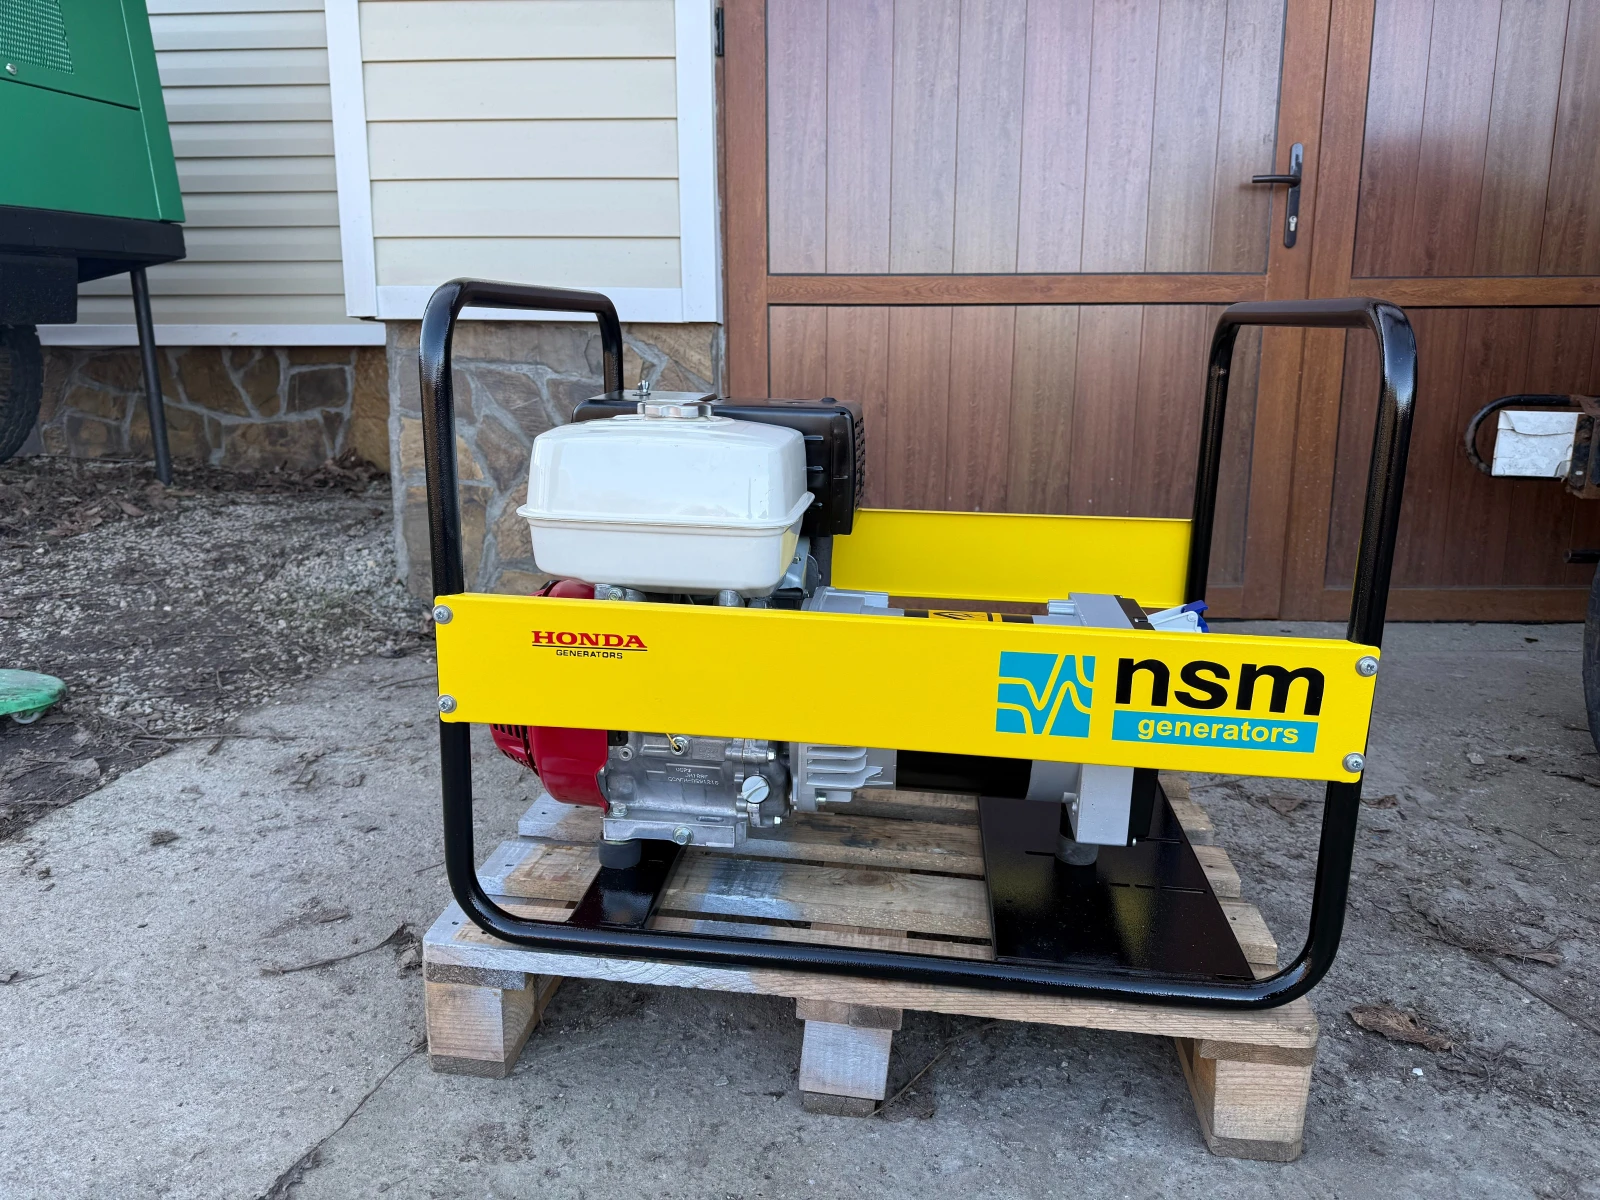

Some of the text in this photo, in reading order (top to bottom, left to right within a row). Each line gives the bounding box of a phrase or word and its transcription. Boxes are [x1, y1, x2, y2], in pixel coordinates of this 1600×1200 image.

[531, 631, 648, 648] HONDA
[556, 649, 623, 660] GENERATORS
[1115, 658, 1325, 716] nsm
[1137, 718, 1299, 744] generators
